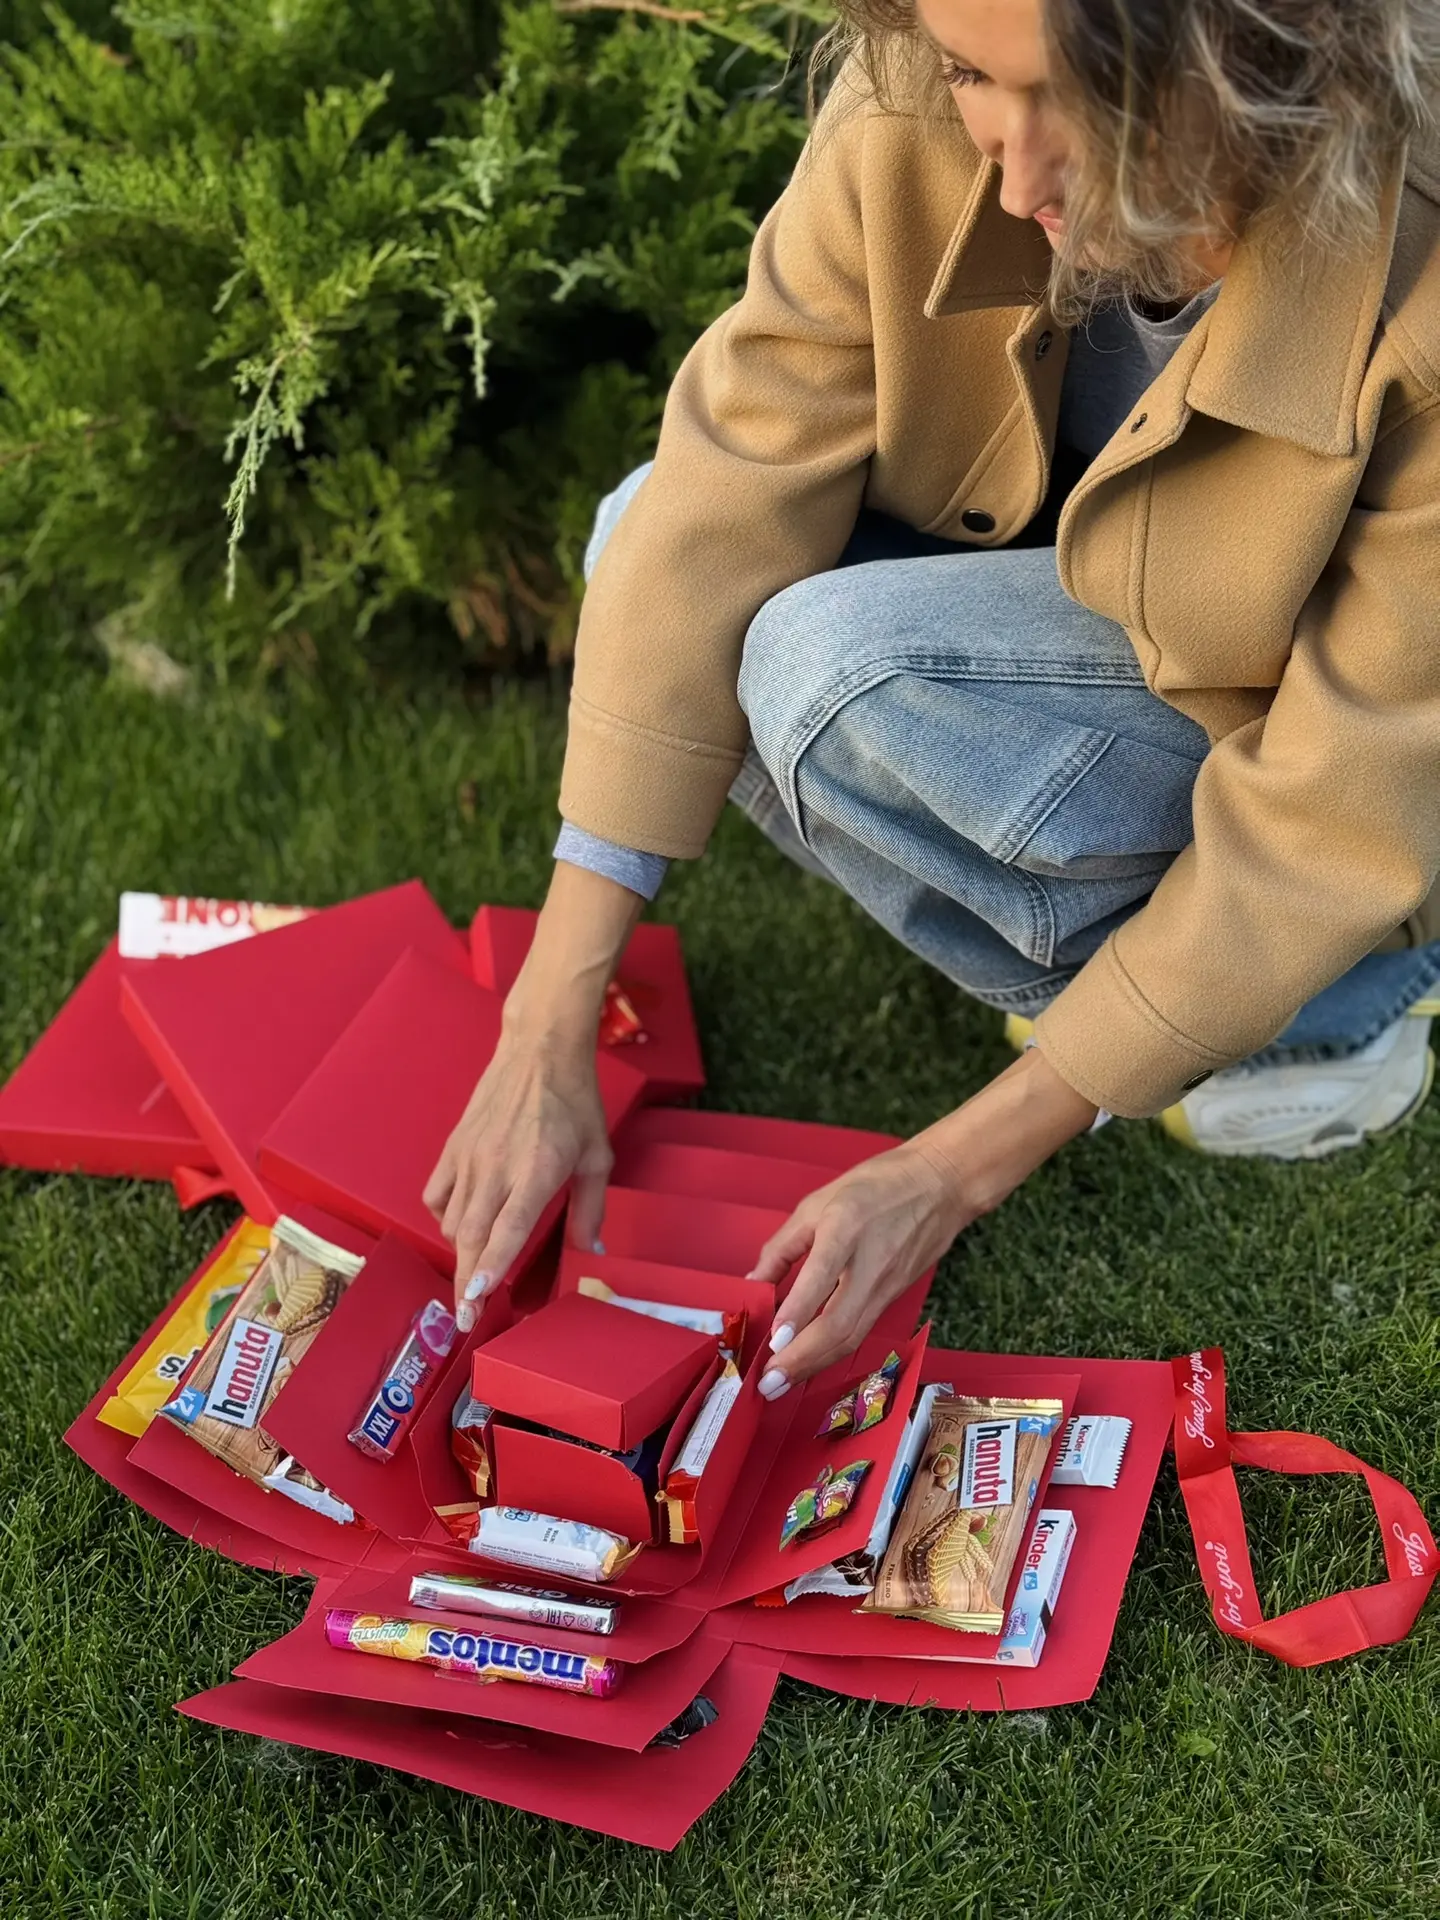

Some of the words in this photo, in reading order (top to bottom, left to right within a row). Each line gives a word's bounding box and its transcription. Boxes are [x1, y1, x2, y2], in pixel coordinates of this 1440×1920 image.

[212, 1327, 271, 1419] hanuta
[368, 1412, 395, 1441] XXL
[387, 1355, 427, 1407] Orbit
[1183, 1373, 1212, 1413] for
[1184, 1400, 1215, 1448] Just
[973, 1424, 1010, 1504] hanuta
[499, 1581, 568, 1599] Orbit
[428, 1630, 586, 1682] mentos
